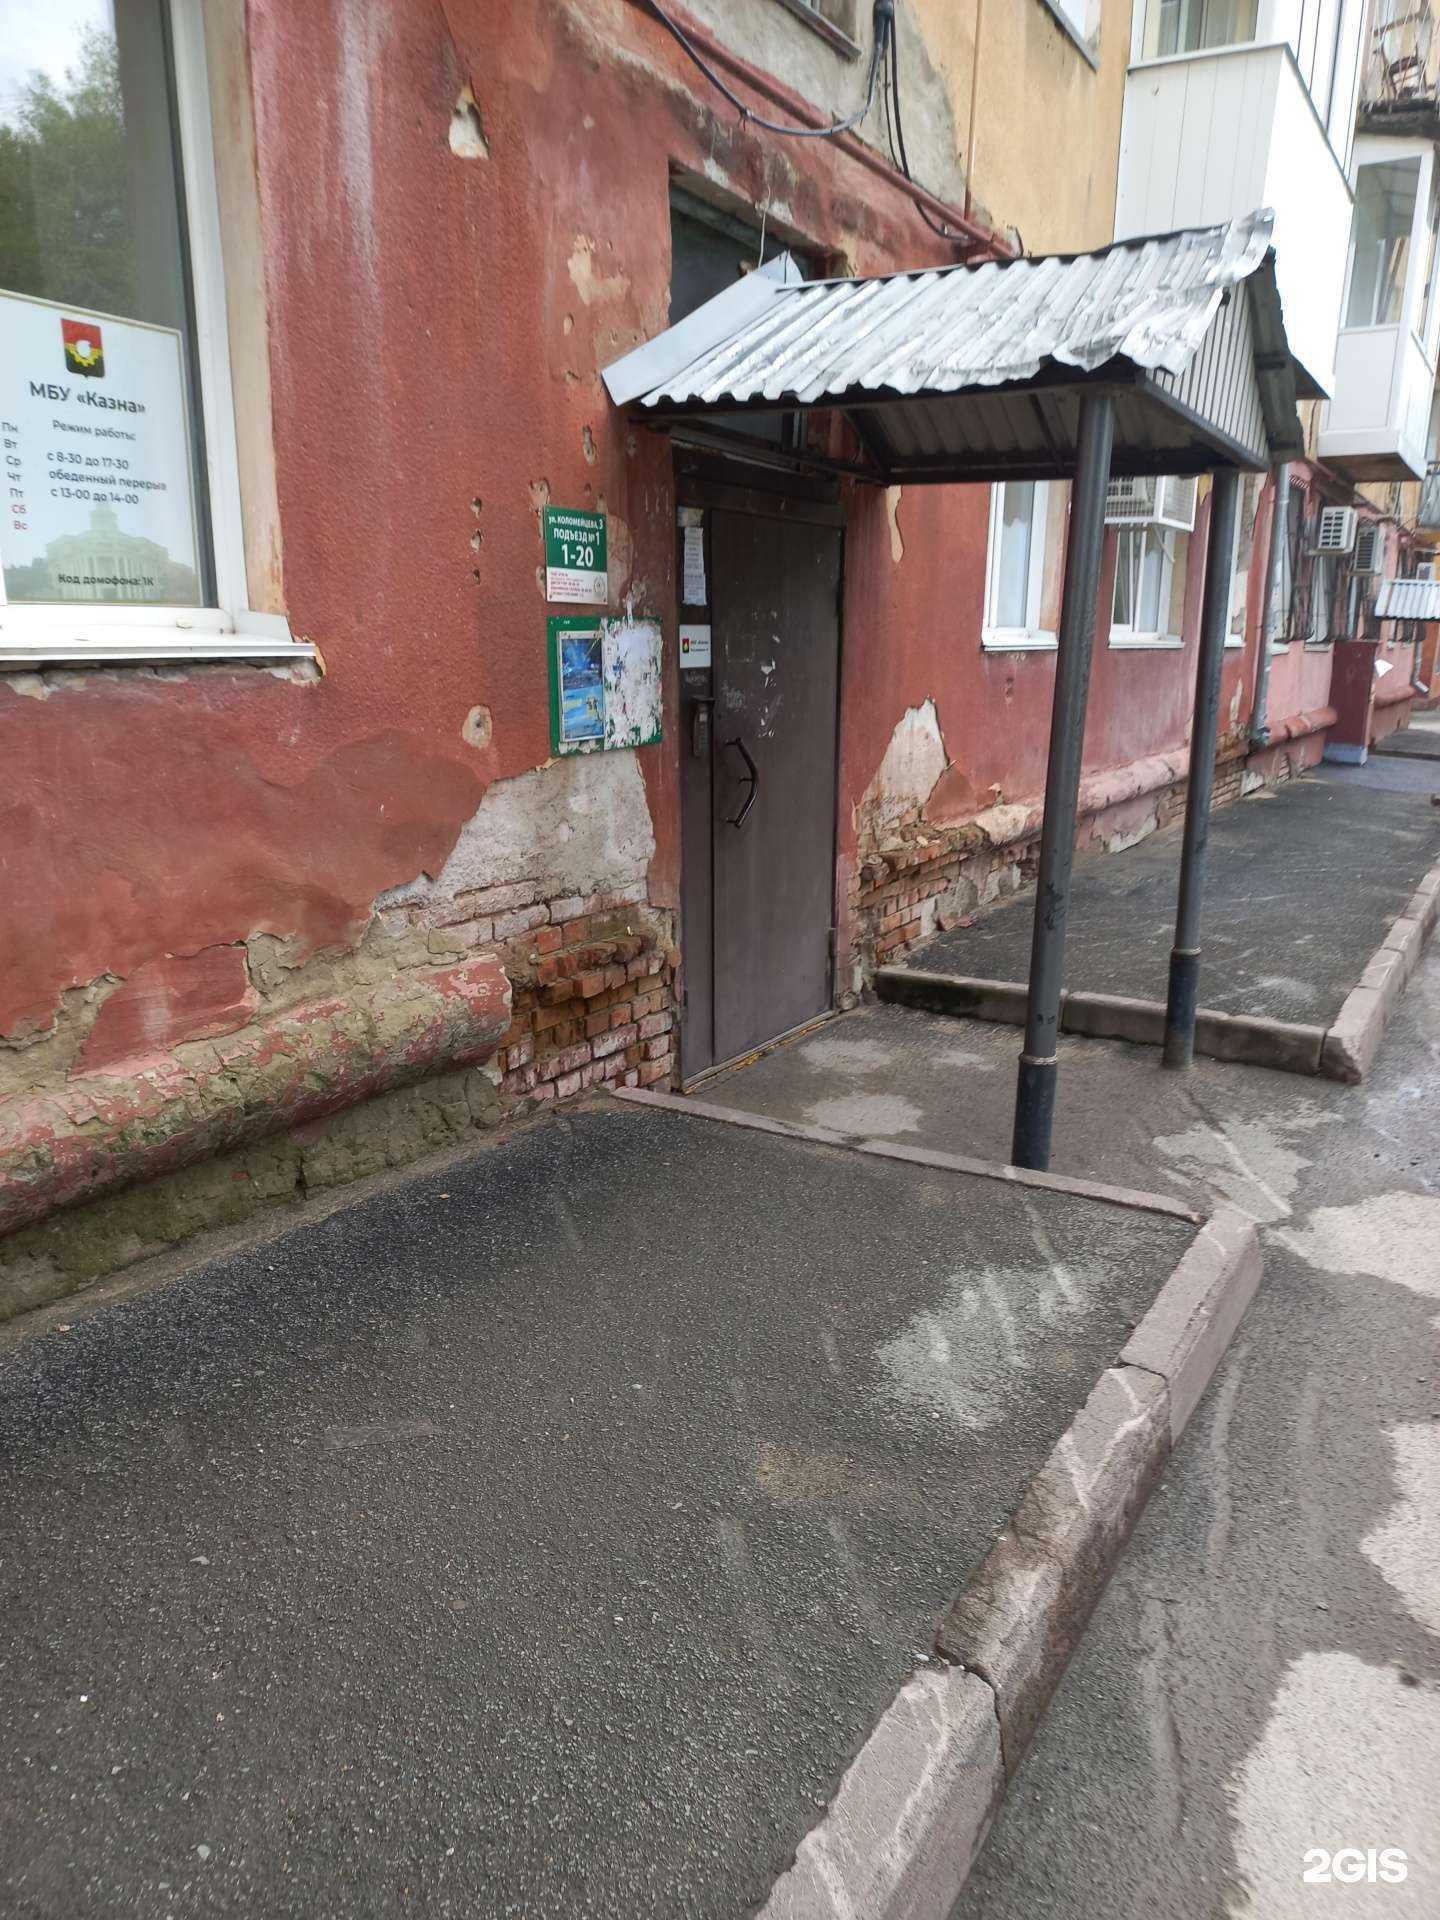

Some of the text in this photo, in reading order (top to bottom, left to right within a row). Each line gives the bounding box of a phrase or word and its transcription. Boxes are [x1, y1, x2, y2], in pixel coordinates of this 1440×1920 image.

[29, 381, 146, 414] МБУ «Казна»
[1, 421, 18, 433] Пн
[52, 419, 92, 434] Режим
[3, 438, 17, 449] Вт
[6, 455, 22, 466] Ср
[56, 451, 82, 465] 8-30
[85, 457, 100, 467] до
[102, 457, 130, 470] 17-30
[7, 472, 22, 482] Чт
[49, 469, 168, 491] обеденный перерыв
[9, 488, 24, 498] Пт
[60, 487, 91, 501] 13-00
[93, 493, 107, 503] до
[110, 492, 140, 504] 14-00
[12, 504, 27, 514] Сб
[14, 520, 28, 531] Вс
[599, 519, 604, 530] 3
[553, 528, 588, 544] ПОДЪЕЗД
[561, 543, 594, 568] 1-20
[58, 573, 80, 584] Код
